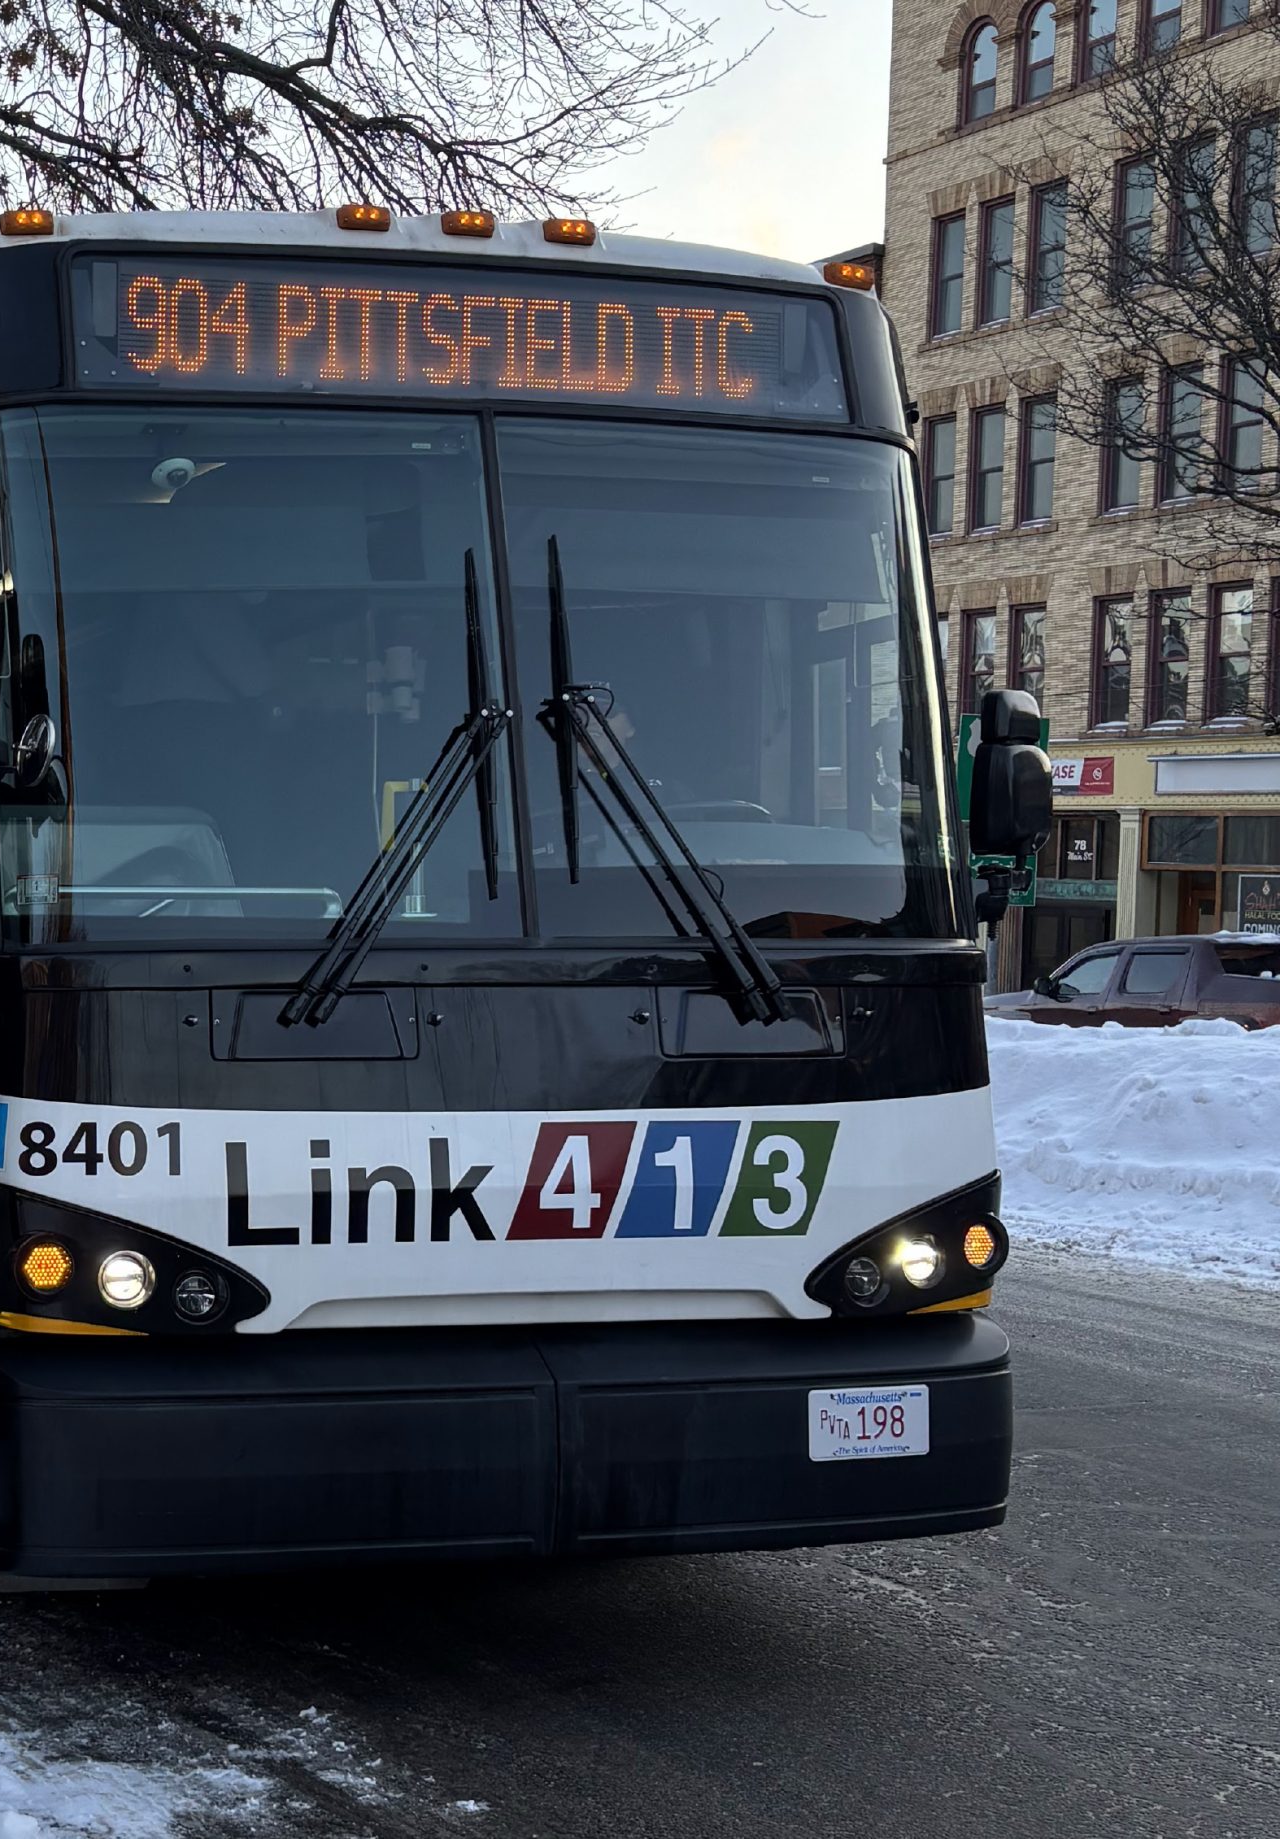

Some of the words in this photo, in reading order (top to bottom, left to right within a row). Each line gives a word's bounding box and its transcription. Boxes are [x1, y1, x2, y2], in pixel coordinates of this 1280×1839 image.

[126, 275, 250, 375] 904
[276, 283, 635, 393] PITTSFIELD
[656, 305, 755, 399] ITC
[1051, 764, 1076, 780] ASE
[1074, 839, 1086, 850] 78
[18, 1121, 183, 1177] 8401
[225, 1121, 840, 1245] Link413
[836, 1391, 903, 1406] Massachusetts
[820, 1409, 851, 1440] PVTA
[857, 1404, 905, 1440] 198
[837, 1447, 850, 1455] The
[851, 1446, 869, 1455] Spirit
[869, 1446, 877, 1454] of
